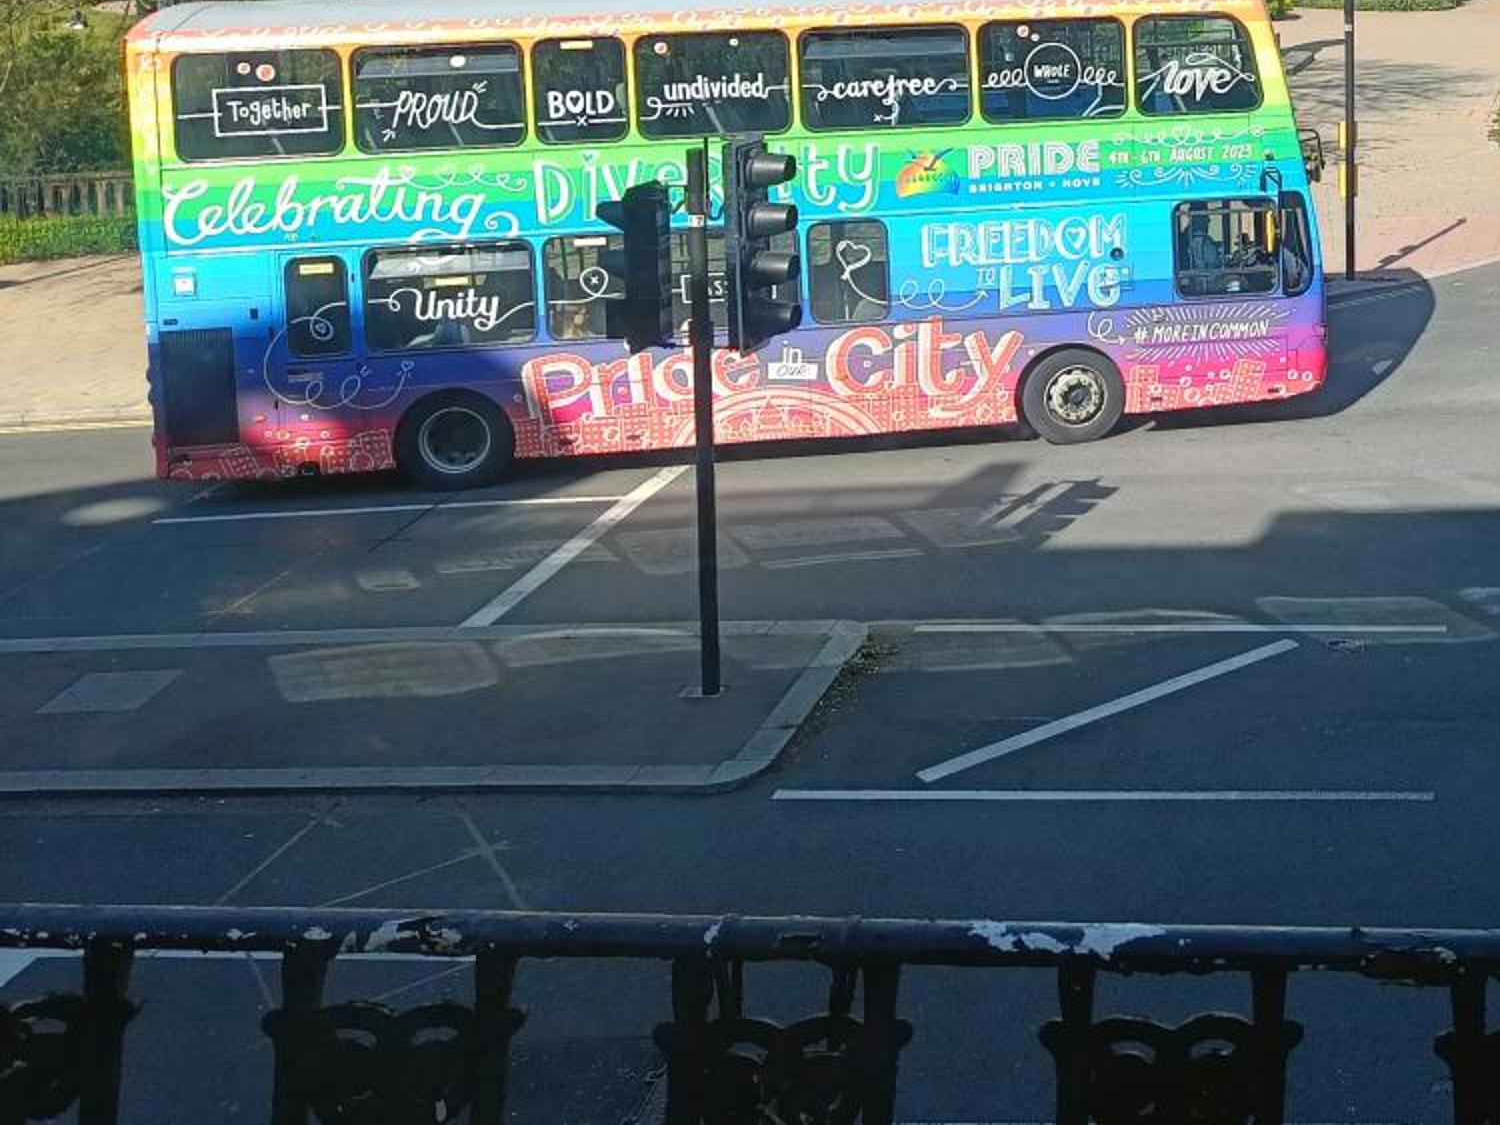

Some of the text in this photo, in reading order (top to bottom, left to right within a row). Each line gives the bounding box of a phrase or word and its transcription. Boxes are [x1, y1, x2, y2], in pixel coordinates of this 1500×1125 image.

[664, 72, 768, 101] undivided
[832, 75, 940, 105] carefree
[1163, 61, 1231, 101] love
[227, 96, 311, 125] Together
[392, 89, 481, 130] PROUD
[547, 90, 615, 119] BOLD
[967, 139, 1101, 180] PRIDE
[1170, 145, 1215, 162] AUGUST
[162, 166, 486, 244] Celebrating
[969, 177, 1101, 194] BRIGHTON HOVE
[921, 213, 1128, 268] FREEDOM
[976, 260, 1121, 311] TO LIVE
[414, 288, 500, 332] Unity
[782, 340, 802, 363] in
[826, 315, 1025, 418] City
